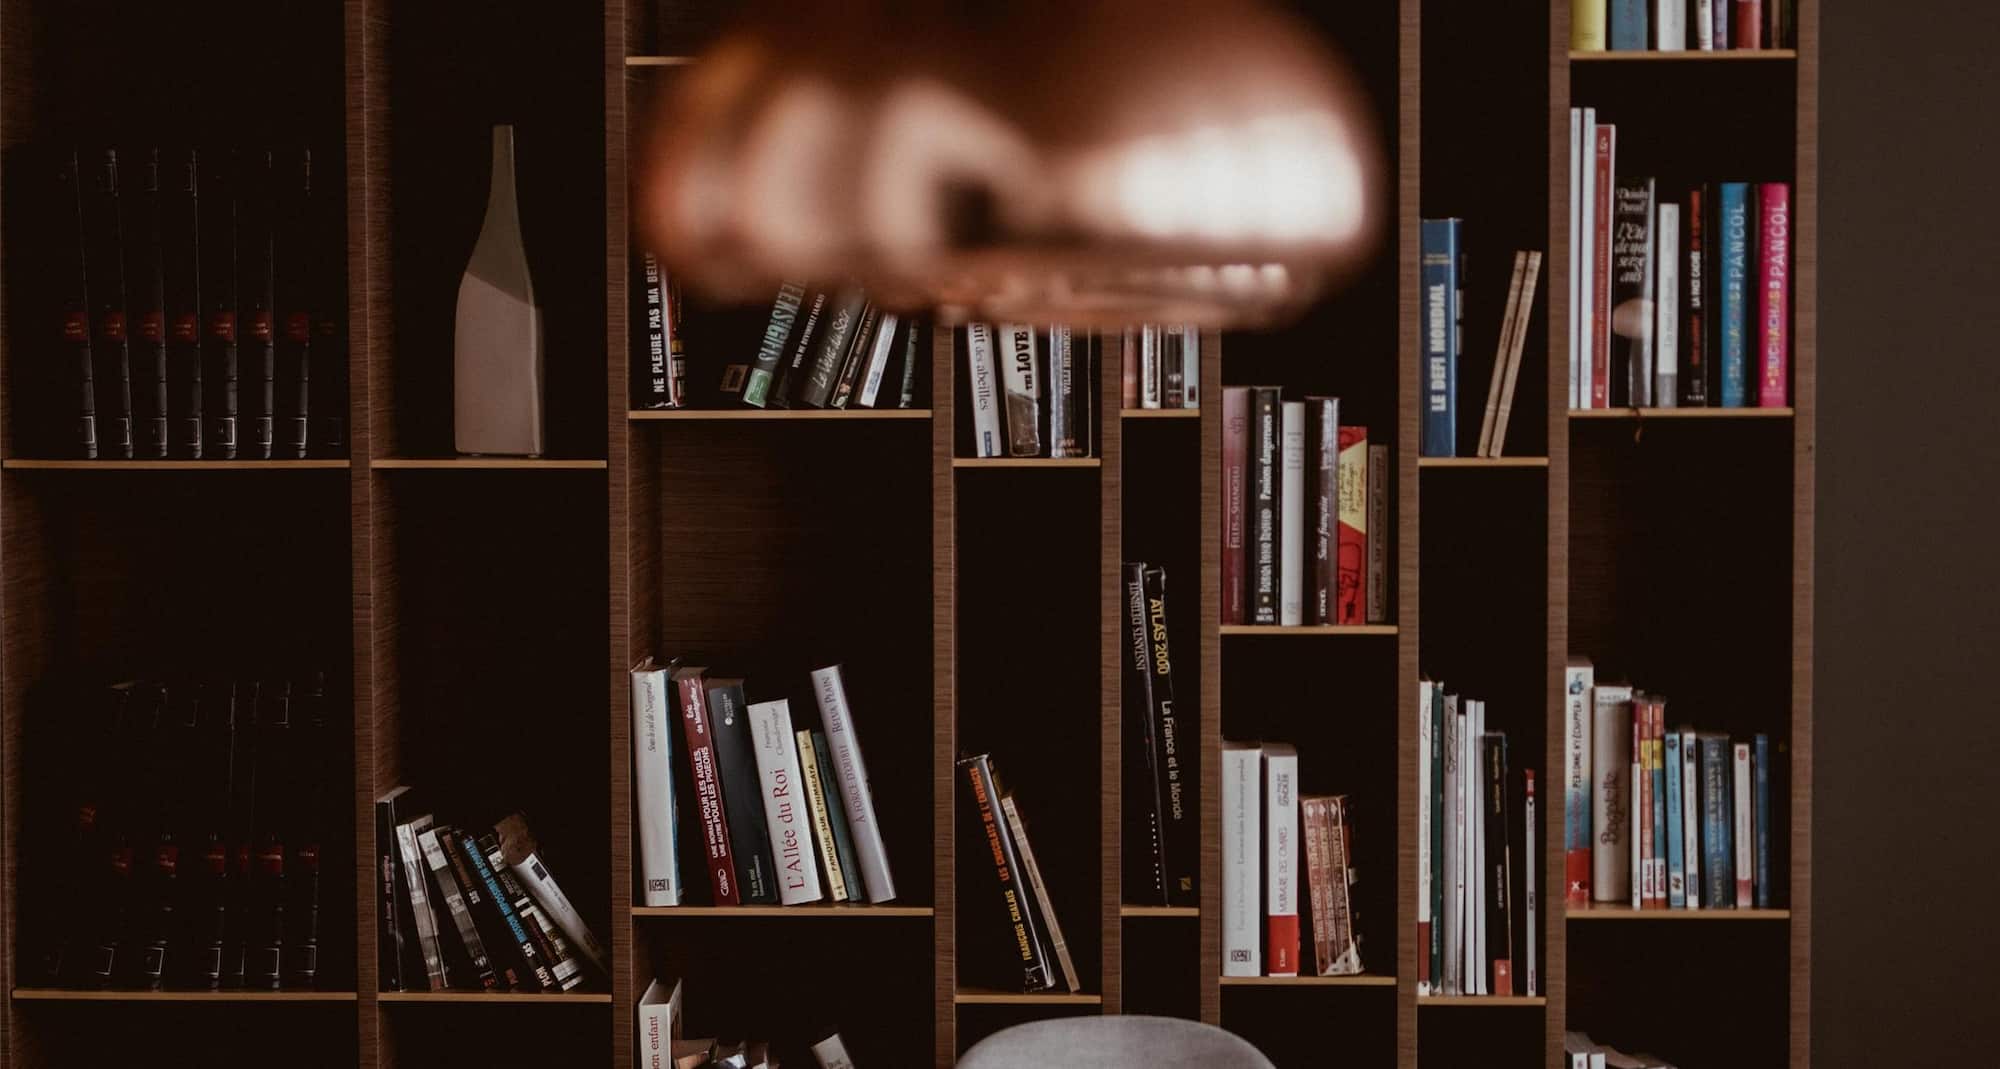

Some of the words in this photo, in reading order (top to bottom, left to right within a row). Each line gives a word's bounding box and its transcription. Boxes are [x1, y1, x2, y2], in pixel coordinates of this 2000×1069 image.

[1730, 203, 1745, 279] PANCOL
[1770, 201, 1787, 277] PANCOL
[646, 287, 660, 304] MA
[648, 308, 661, 329] PAS
[1430, 283, 1445, 352] MONDIAL
[650, 333, 663, 374] PLEURE
[1014, 331, 1031, 373] LOVE
[652, 377, 665, 393] NE
[1024, 374, 1033, 391] THE
[1431, 357, 1446, 390] DEFI
[975, 365, 991, 411] abeilles
[1431, 394, 1446, 411] LE
[1149, 598, 1165, 642] ATLAS
[1132, 627, 1146, 671] INSTANTS
[1154, 642, 1170, 675] 2000
[822, 676, 837, 703] PLAIN
[1160, 700, 1174, 715] La
[1162, 717, 1177, 755] France
[701, 747, 714, 783] PIGEONS
[1168, 757, 1180, 768] et
[1170, 770, 1181, 780] le
[699, 780, 708, 796] LES
[706, 784, 716, 800] LES
[770, 768, 790, 798] Roi
[702, 796, 714, 820] POUR
[848, 784, 863, 812] FORCE
[1171, 782, 1184, 820] Monde
[710, 801, 721, 823] POUR
[777, 802, 794, 824] du
[818, 816, 829, 832] SUR
[982, 810, 993, 822] DE
[715, 823, 725, 842] AUTRE
[984, 823, 1006, 866] CHOCOLATS
[710, 845, 719, 859] UNE
[718, 843, 727, 857] UNE
[781, 829, 805, 890] L'Allée
[824, 834, 838, 872] PANIQUE
[998, 866, 1011, 881] LES
[1004, 889, 1022, 921] CHALAIS
[521, 942, 537, 958] SAS
[1014, 923, 1033, 961] FRANÇOIS
[535, 965, 553, 987] PLON
[648, 1016, 659, 1050] enfant
